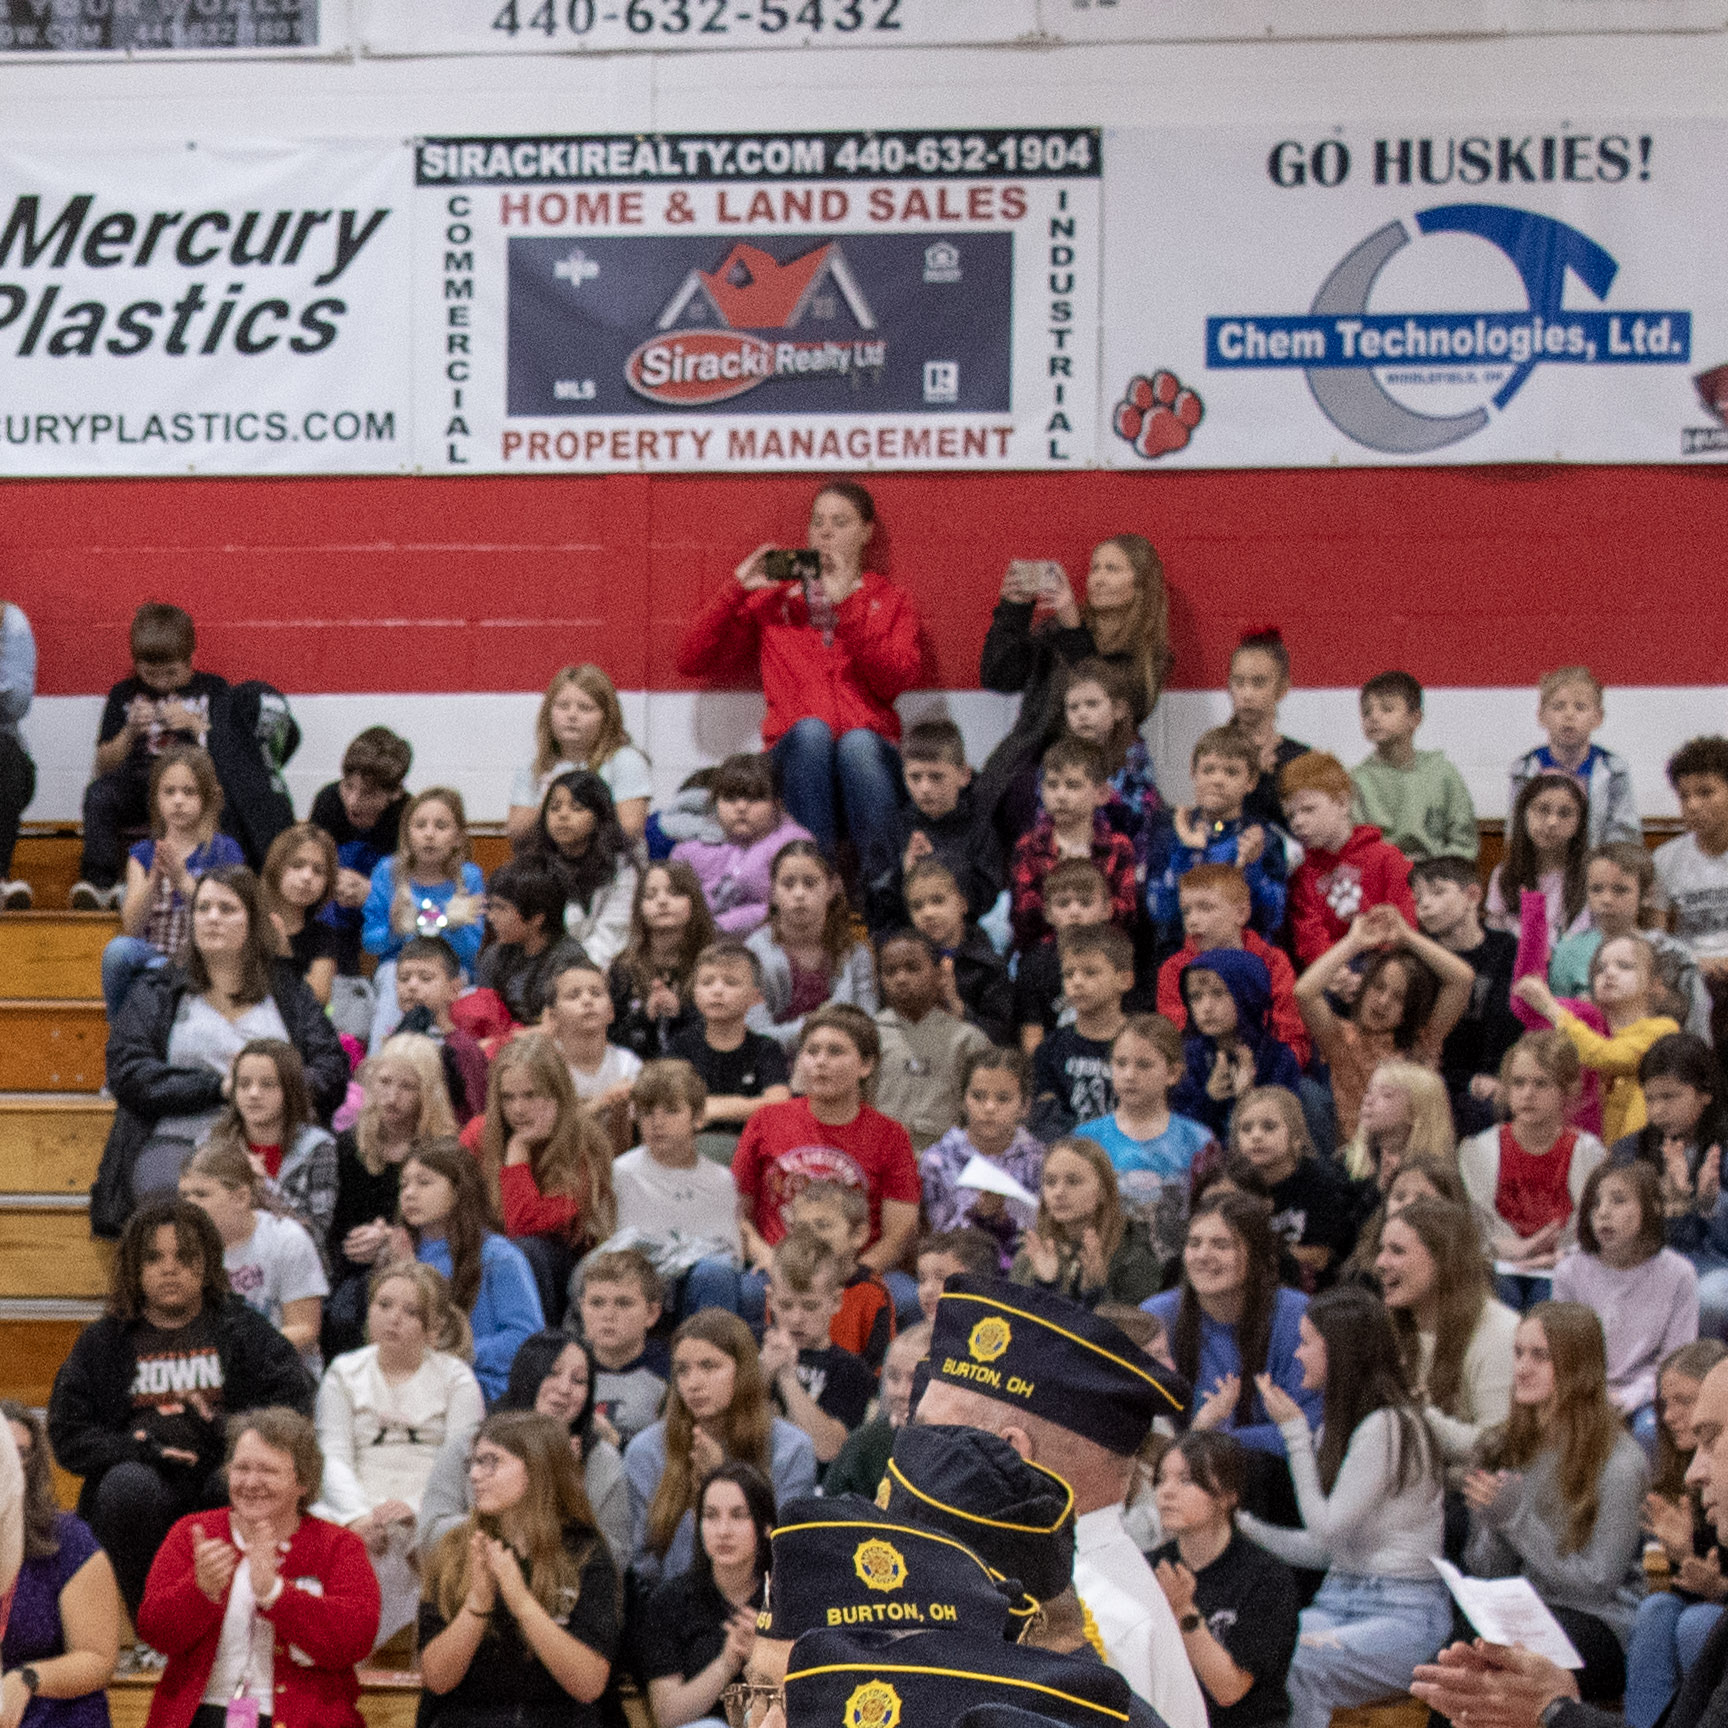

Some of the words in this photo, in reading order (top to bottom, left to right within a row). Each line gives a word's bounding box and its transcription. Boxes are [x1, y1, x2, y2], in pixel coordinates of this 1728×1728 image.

[491, 0, 904, 36] 440-632-5432
[421, 138, 825, 181] SIRACKIREALTY.COM
[834, 135, 1091, 173] 440-632-1904
[1267, 140, 1352, 189] GO
[1372, 135, 1655, 186] HUSKIES!
[501, 190, 644, 228] HOME
[663, 191, 697, 224] &
[717, 188, 851, 224] LAND
[868, 186, 1029, 222] SALES
[445, 194, 475, 465] COMMERCIAL
[1048, 189, 1076, 462] INDUSTRIAL
[1216, 321, 1325, 361] Chem
[1335, 317, 1598, 362] Technologies,
[1609, 317, 1684, 356] Ltd.
[642, 342, 772, 387] Siracki
[774, 343, 853, 375] Realty
[501, 429, 716, 462] PROPERTY
[727, 425, 1015, 460] MANAGEMENT
[941, 1357, 1003, 1390] BURTON,
[1006, 1375, 1035, 1399] OH
[826, 1602, 926, 1627] BURTON,
[928, 1603, 958, 1623] OH
